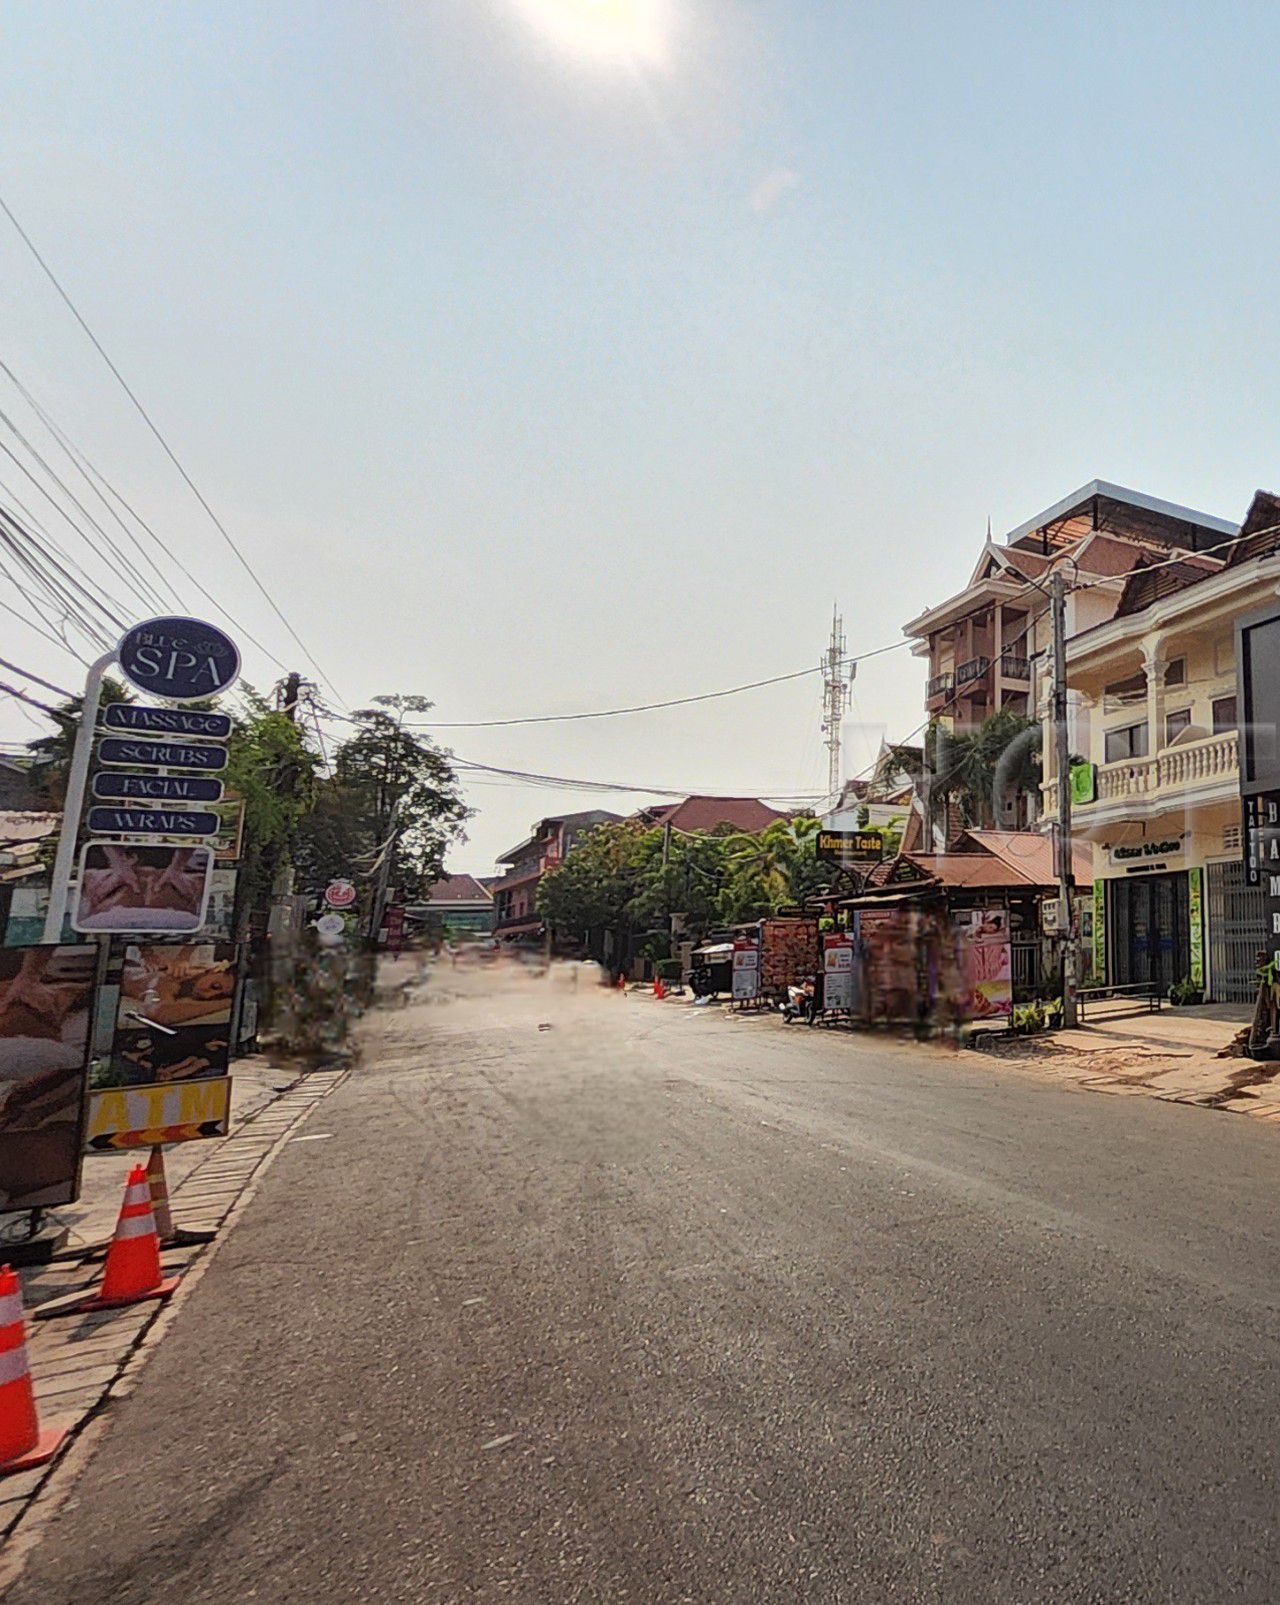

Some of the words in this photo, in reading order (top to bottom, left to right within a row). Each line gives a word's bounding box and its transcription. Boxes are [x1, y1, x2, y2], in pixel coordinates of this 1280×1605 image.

[130, 646, 221, 686] SPA
[115, 709, 222, 732] MASSAGE
[119, 743, 209, 764] SCRUBS
[122, 778, 197, 797] FACIAL
[114, 813, 197, 829] WRAPS
[819, 834, 854, 849] Khmer
[855, 835, 881, 850] Taste
[1247, 800, 1258, 882] TATTOO
[90, 1079, 225, 1134] ATM
